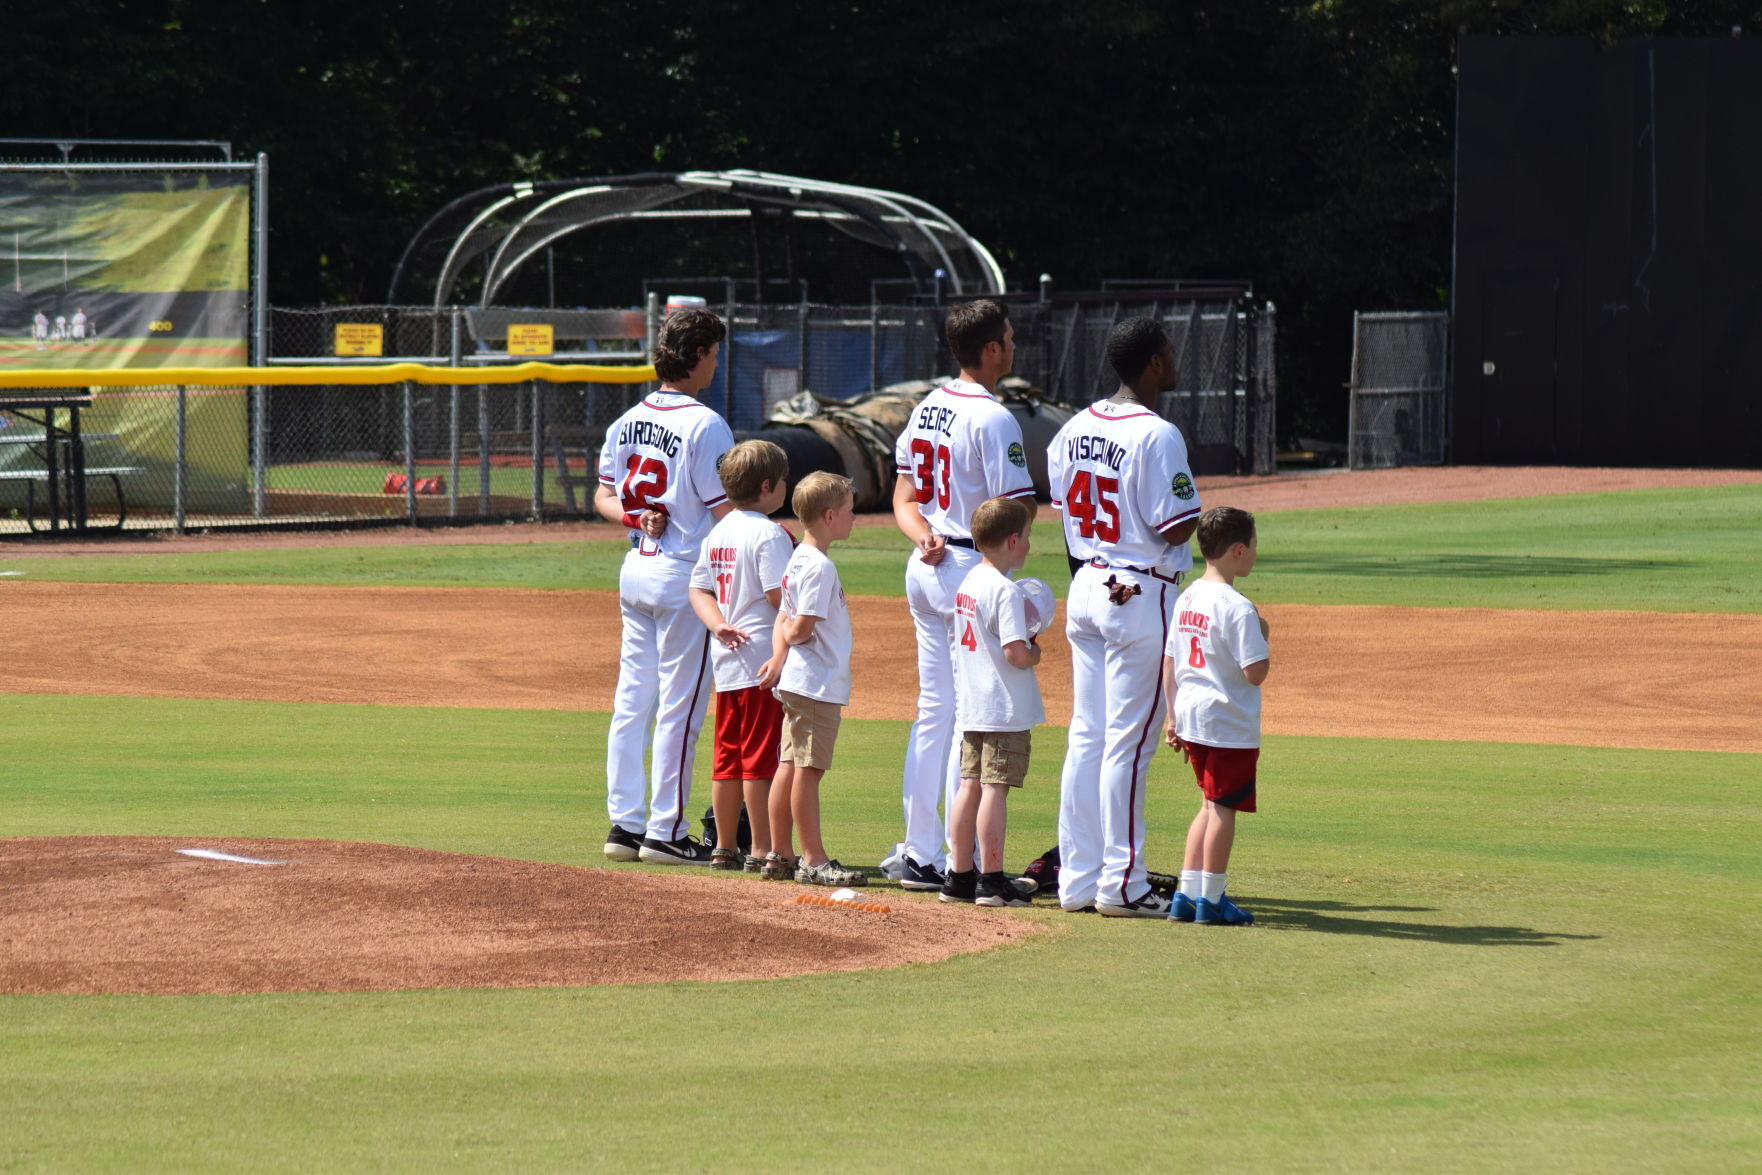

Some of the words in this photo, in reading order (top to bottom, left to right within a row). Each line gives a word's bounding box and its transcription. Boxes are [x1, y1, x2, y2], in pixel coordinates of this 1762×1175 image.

[619, 421, 682, 458] BIRDSONG
[1068, 436, 1126, 471] VISCAINO
[621, 453, 671, 517] 12
[911, 438, 950, 511] 33
[1067, 470, 1120, 544] 45
[709, 548, 737, 562] WOODS
[961, 620, 977, 652] 4
[1189, 636, 1206, 669] 6
